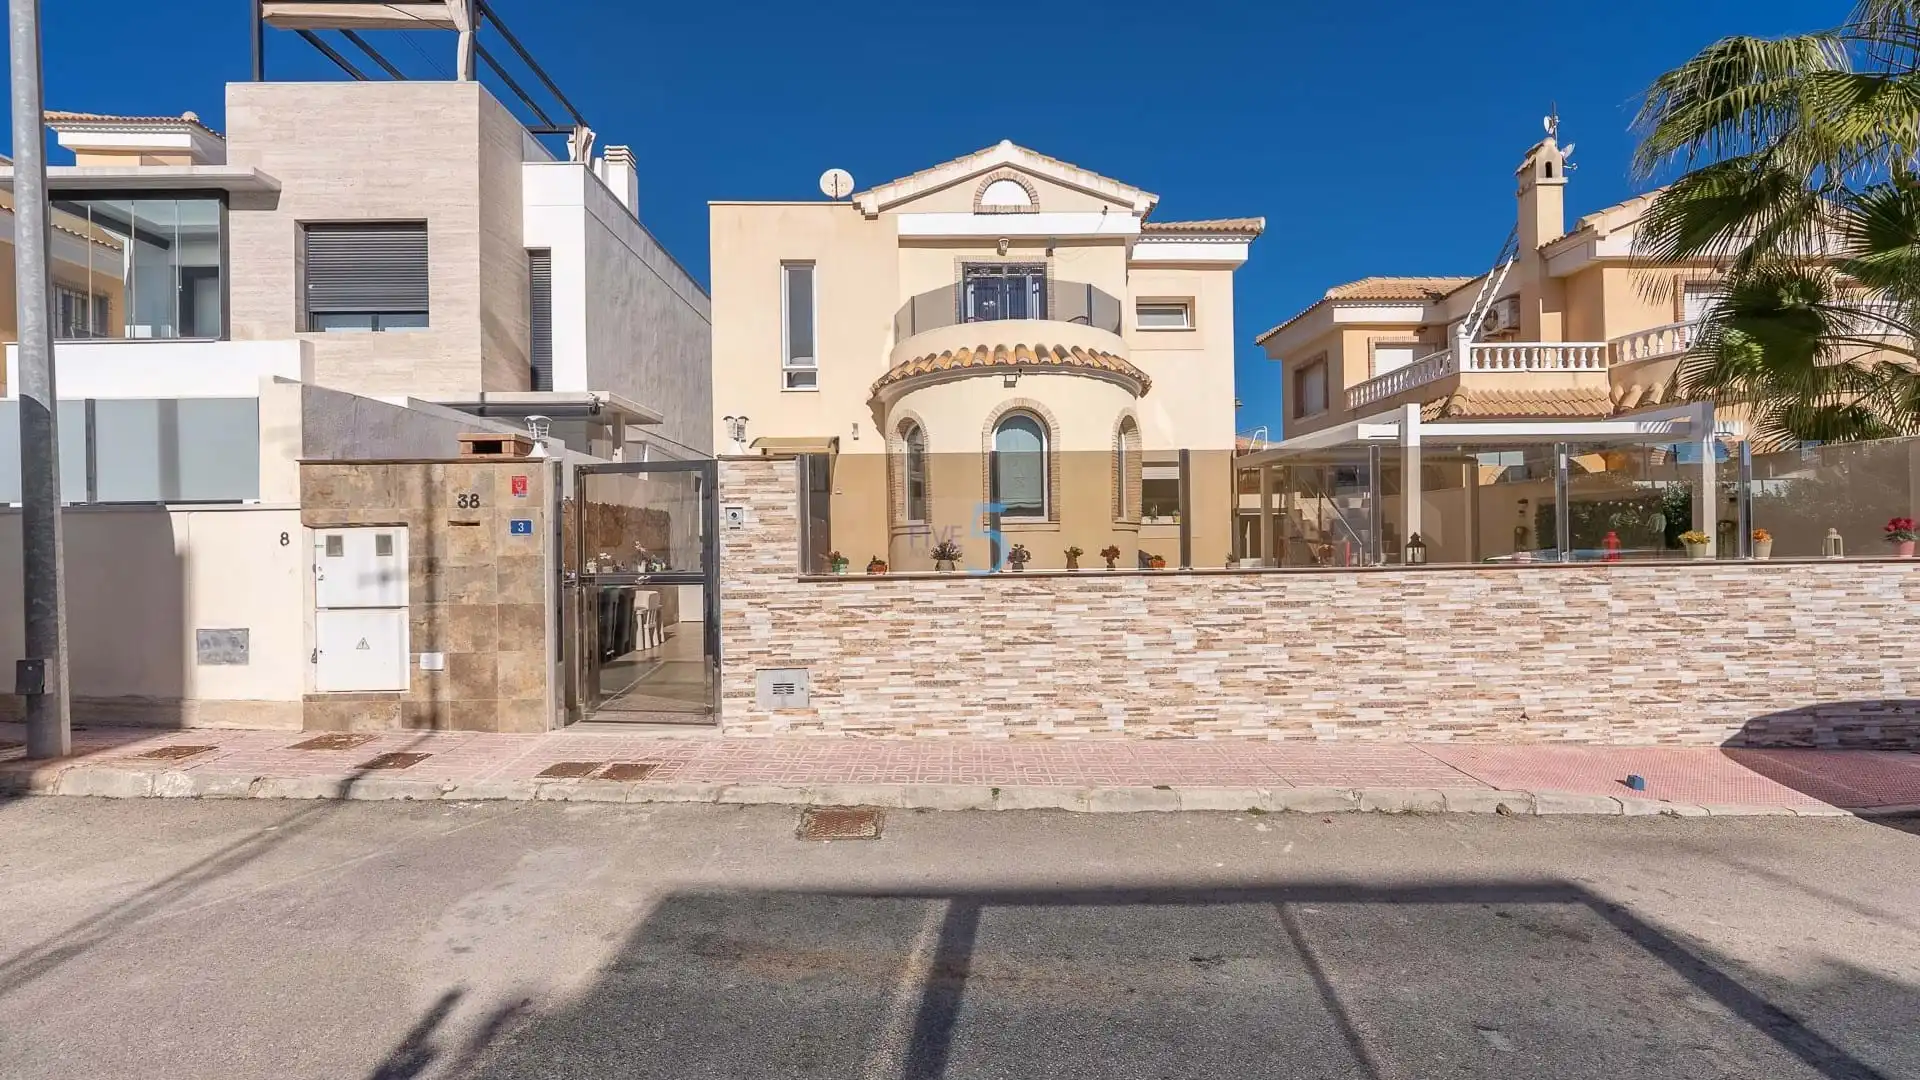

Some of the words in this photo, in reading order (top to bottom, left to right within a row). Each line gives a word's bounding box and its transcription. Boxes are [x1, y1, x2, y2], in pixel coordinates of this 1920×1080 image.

[457, 493, 480, 508] 38
[517, 522, 525, 532] 3
[280, 531, 290, 546] 8
